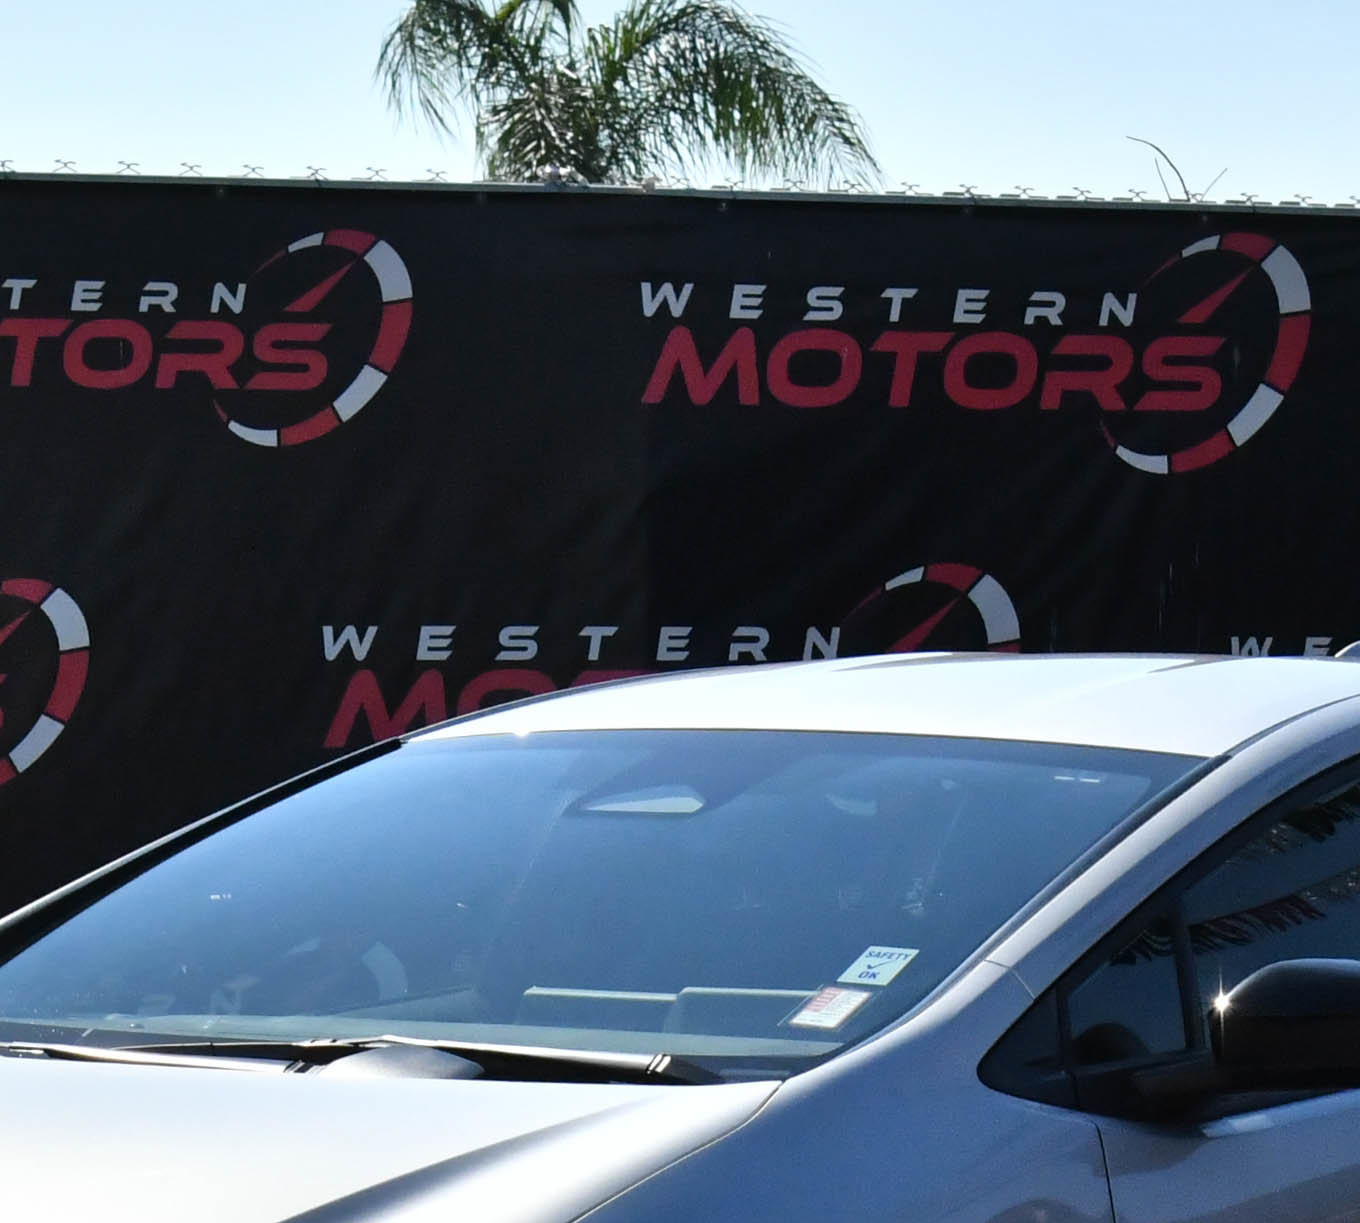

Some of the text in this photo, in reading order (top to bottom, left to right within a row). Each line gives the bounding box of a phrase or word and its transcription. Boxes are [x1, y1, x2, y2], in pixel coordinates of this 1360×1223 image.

[641, 282, 1137, 327] WESTERN
[642, 325, 1226, 412] MOTORS
[322, 625, 840, 661] WESTERN
[865, 951, 912, 961] SAFETY
[858, 971, 880, 980] OK
